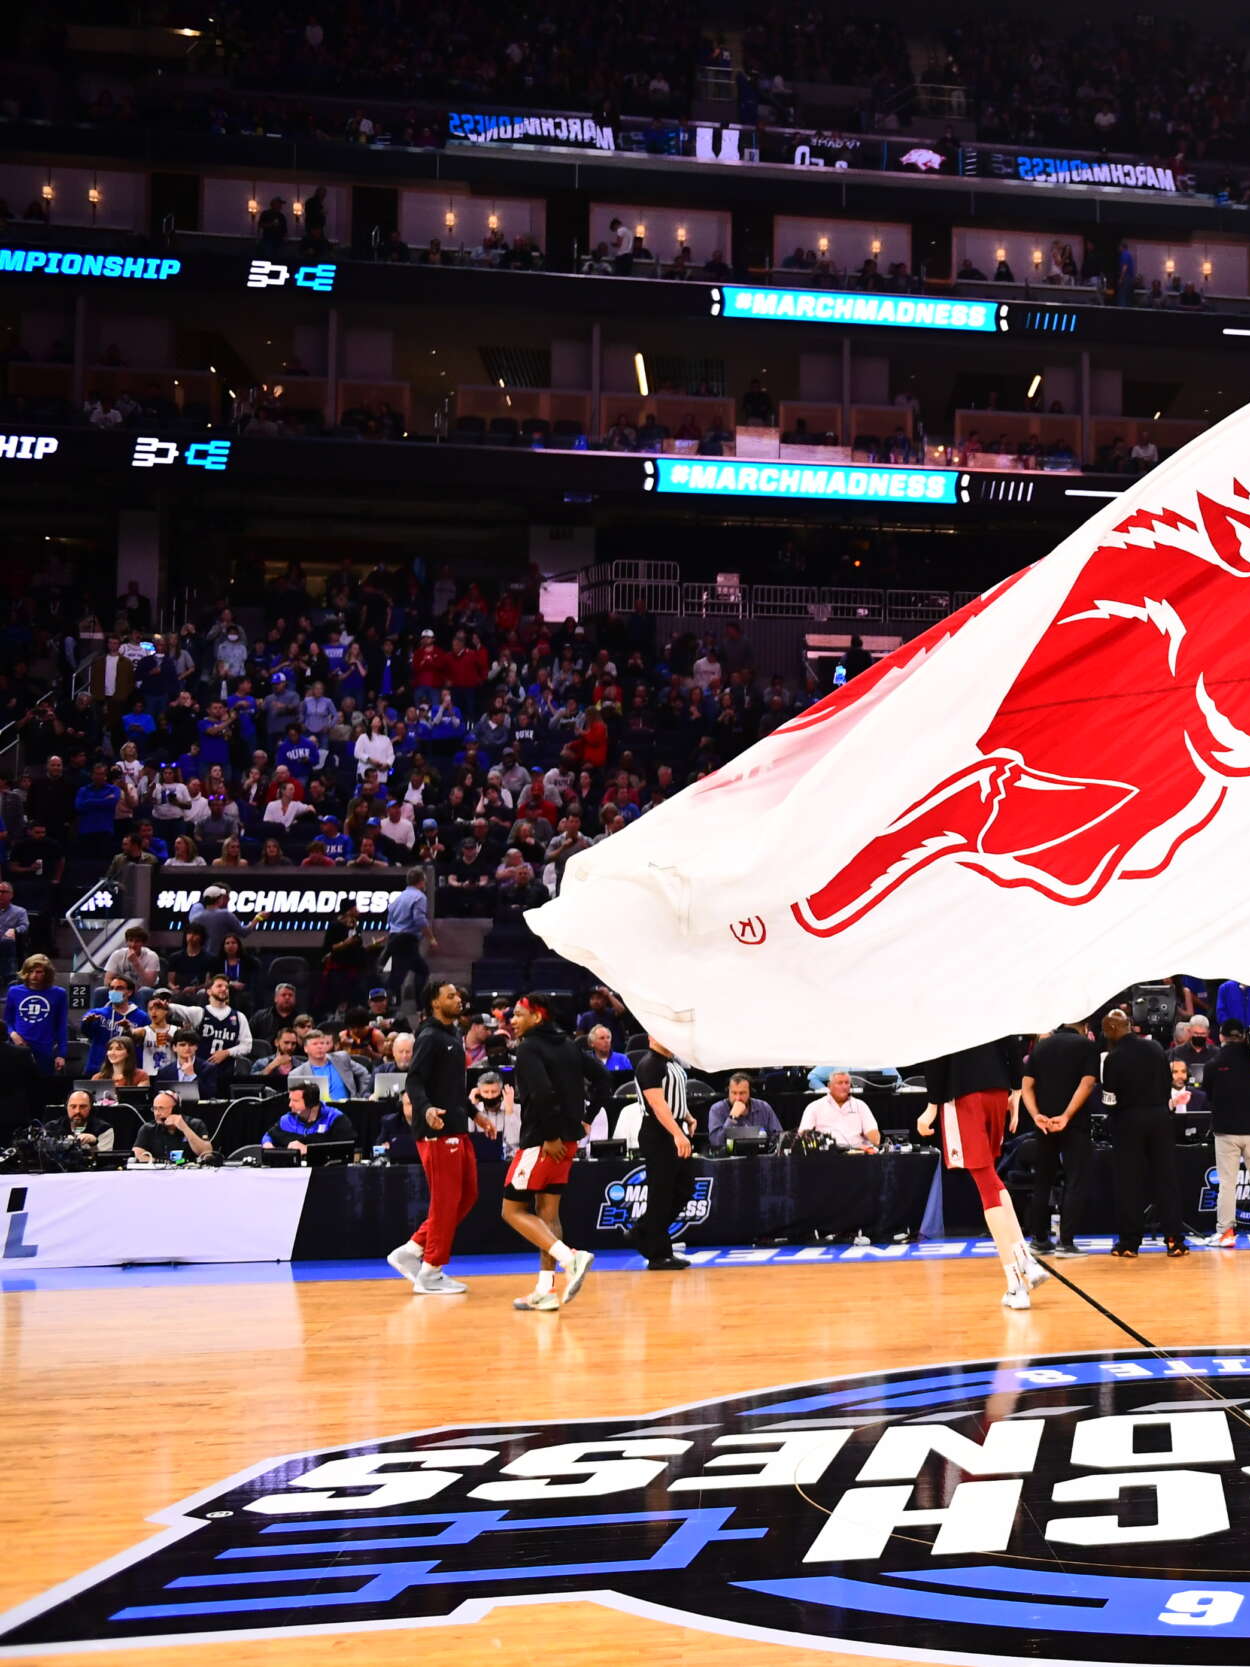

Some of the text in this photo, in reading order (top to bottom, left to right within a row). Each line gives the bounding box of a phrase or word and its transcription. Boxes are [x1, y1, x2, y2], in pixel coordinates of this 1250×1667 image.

[0, 249, 181, 280] MPIONSHIP
[735, 292, 987, 327] #MARCHMADNESS
[0, 434, 59, 460] HIP
[670, 464, 945, 499] #MARCHMADNESS
[72, 986, 87, 996] 22
[1013, 1368, 1078, 1384] 8
